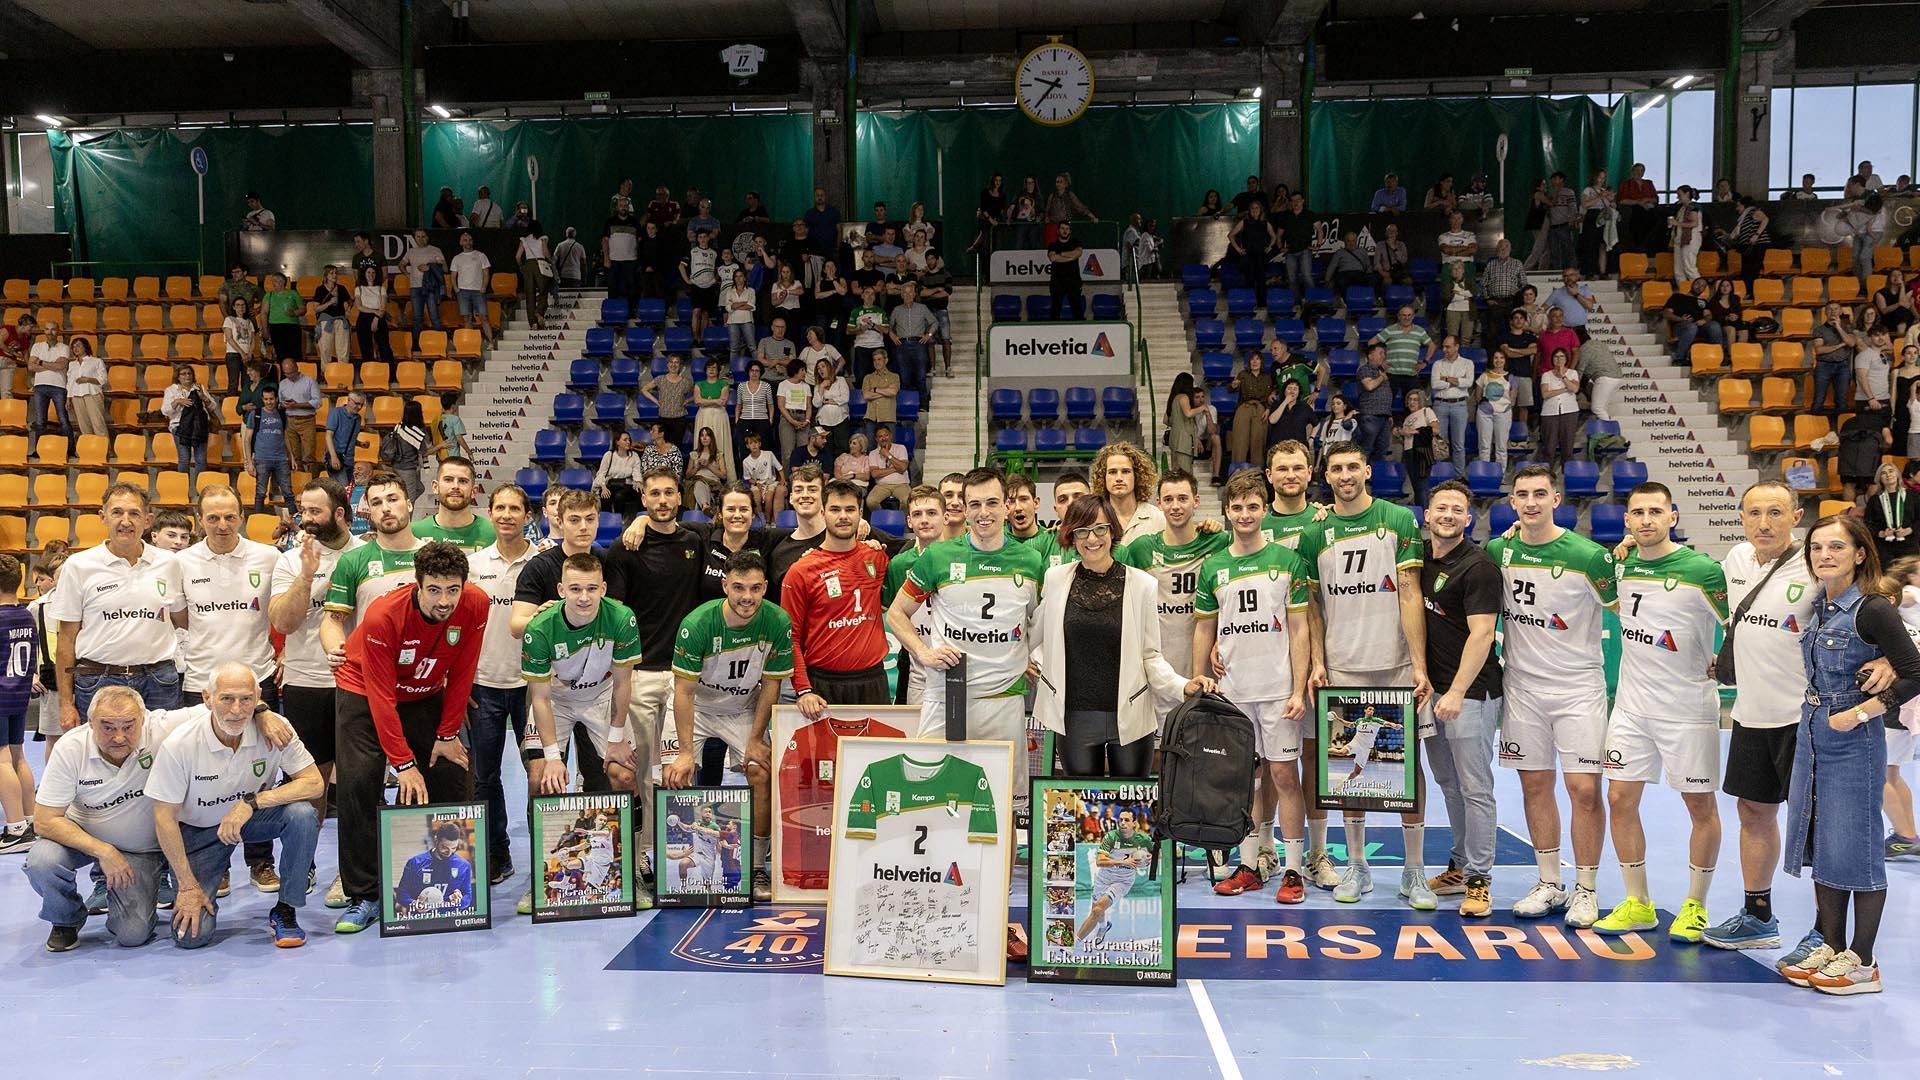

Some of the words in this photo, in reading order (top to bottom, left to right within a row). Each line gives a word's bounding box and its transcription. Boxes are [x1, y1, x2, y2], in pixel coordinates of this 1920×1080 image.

[737, 56, 749, 67] 17
[1006, 260, 1052, 275] helve
[1005, 338, 1088, 356] helvetia
[500, 384, 528, 392] helvetia
[1624, 395, 1657, 403] helvetia
[1632, 406, 1666, 414] helvetia
[1650, 432, 1685, 440] helvetia
[1658, 446, 1694, 454] helvetia
[1668, 460, 1704, 468] helvetia
[1678, 474, 1714, 482] helvetia
[1688, 488, 1724, 496] helvetia
[1699, 503, 1736, 511] helvetia
[1283, 525, 1304, 533] Kempa
[1344, 524, 1368, 532] Kempa
[712, 549, 728, 560] Kempa
[1521, 553, 1542, 563] Kempa
[978, 564, 1002, 572] Kempa
[1342, 550, 1368, 574] 77
[819, 570, 840, 579] Kempa
[1634, 566, 1655, 576] Kempa
[96, 583, 119, 592] Kempa
[1172, 572, 1196, 594] 30
[1512, 580, 1536, 606] 25
[196, 600, 248, 612] helvetia
[853, 588, 862, 613] 1
[981, 592, 996, 620] 2
[1238, 590, 1258, 613] 19
[1631, 592, 1643, 617] 7
[103, 608, 155, 621] helvetia
[944, 622, 1009, 644] helvetia
[6, 642, 32, 677] 10
[728, 660, 750, 680] 10
[1338, 696, 1358, 704] Nico
[1360, 691, 1411, 704] BONNANO
[78, 778, 103, 786] Kempa
[195, 774, 219, 782] Kempa
[702, 790, 748, 803] TORRIKO
[912, 794, 936, 802] Kempa
[1080, 789, 1116, 801] Álvaro
[1330, 788, 1371, 796] Eskerrik
[536, 803, 560, 812] Niko
[432, 812, 457, 822] Juan
[458, 806, 482, 820] BAR
[914, 826, 928, 854] 2
[873, 863, 942, 884] helvetia
[669, 886, 709, 894] Eskerrik
[712, 886, 740, 894] asko!!
[546, 898, 591, 908] Eskerrik
[592, 895, 621, 904] asko!!
[396, 912, 442, 921] Eskerrik
[444, 906, 475, 918] asko!!
[724, 934, 809, 955] 40
[1084, 937, 1160, 953] ¡¡Gracias!!
[1047, 950, 1110, 966] Eskerrik
[1115, 952, 1160, 966] asko!!
